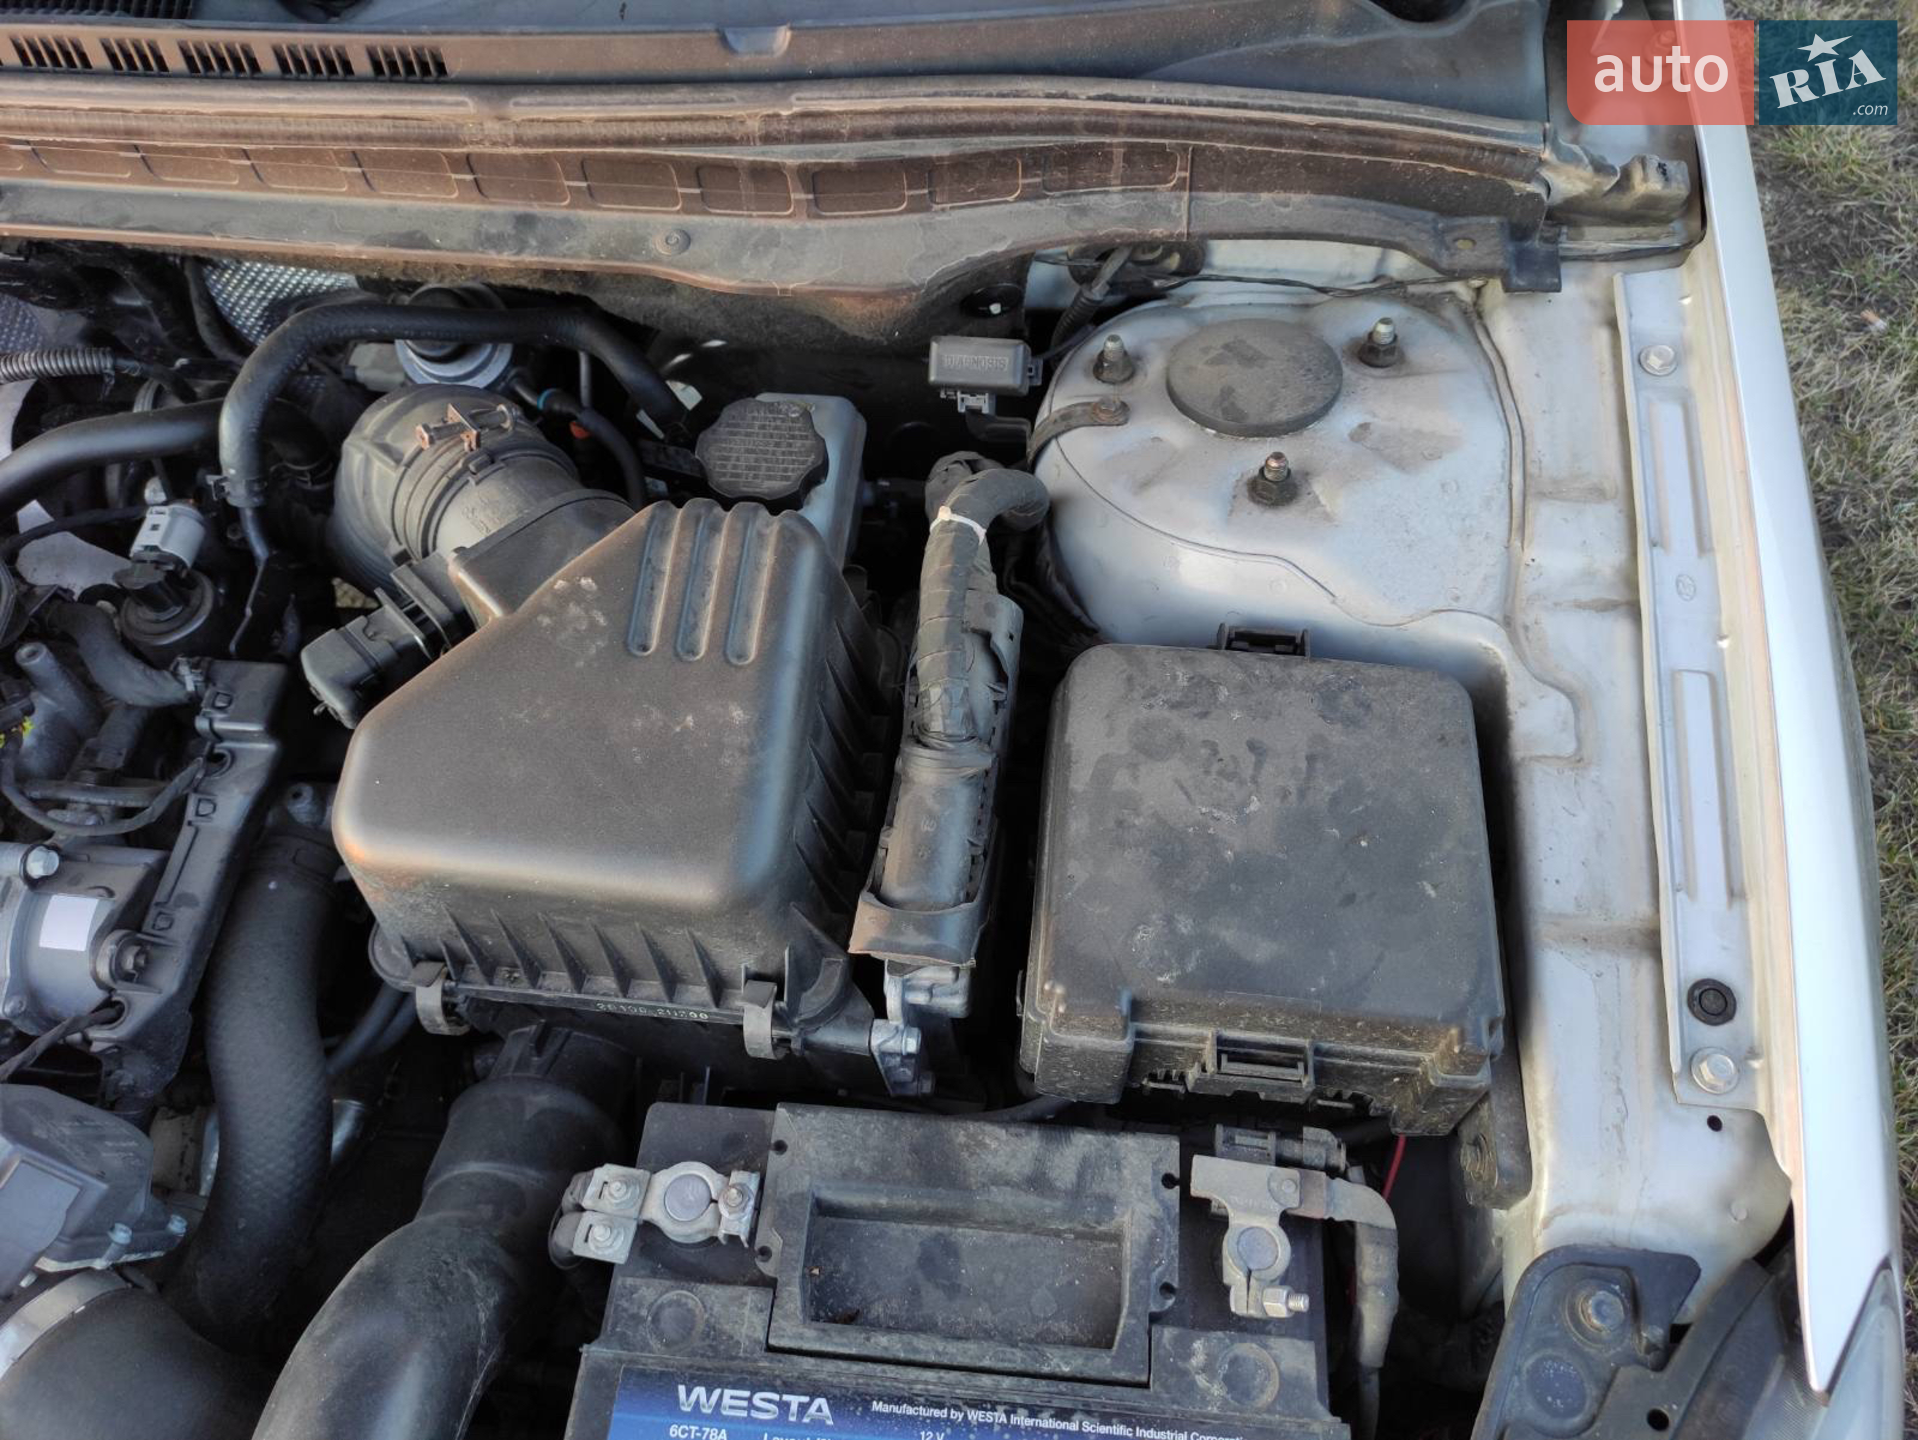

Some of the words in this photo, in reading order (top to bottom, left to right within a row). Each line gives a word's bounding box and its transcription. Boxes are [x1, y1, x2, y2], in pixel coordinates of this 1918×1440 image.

[677, 1384, 834, 1426] WESTA
[871, 1400, 948, 1418] Manufactured
[950, 1410, 965, 1422] by
[967, 1410, 1007, 1424] WESTA
[1010, 1415, 1079, 1431] International
[1081, 1420, 1133, 1437] Scientific
[1136, 1426, 1188, 1440] Industrial
[669, 1424, 728, 1440] 6CT-78A
